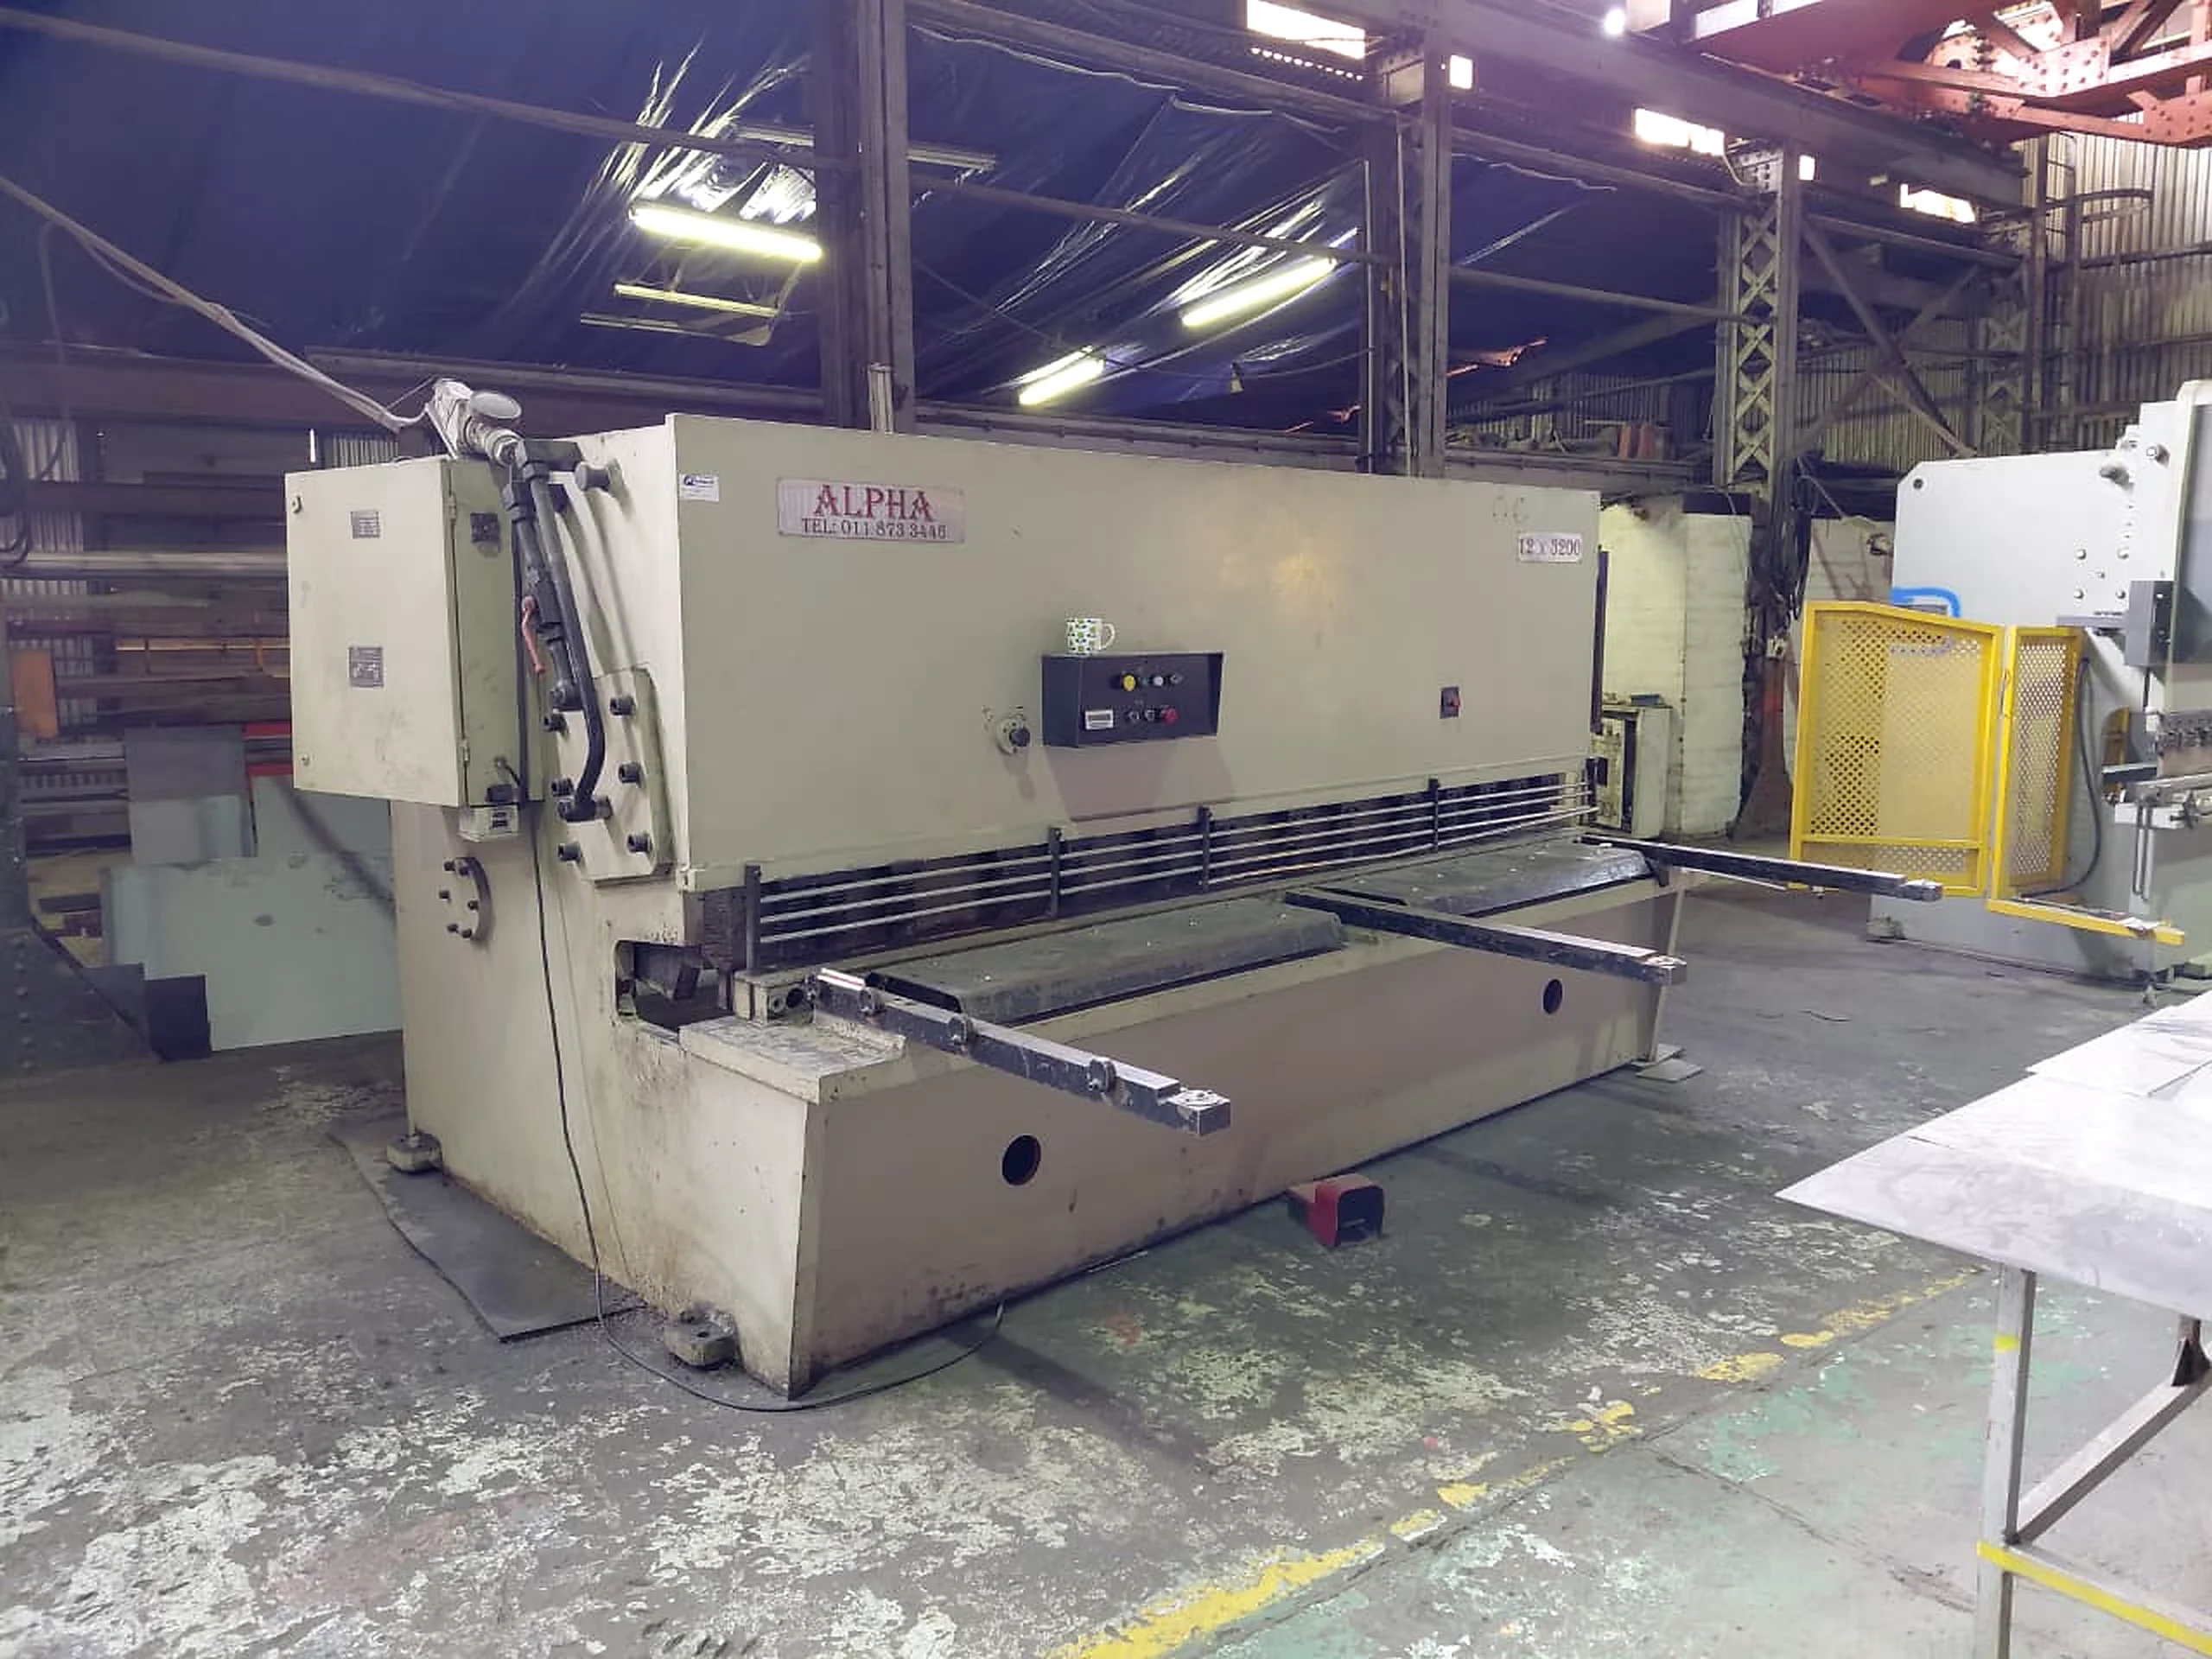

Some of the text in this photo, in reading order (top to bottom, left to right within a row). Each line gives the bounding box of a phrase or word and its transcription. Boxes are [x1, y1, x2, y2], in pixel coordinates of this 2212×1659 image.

[813, 485, 934, 522] ALPHA
[801, 518, 836, 534] TEL:
[1520, 538, 1534, 554] 12
